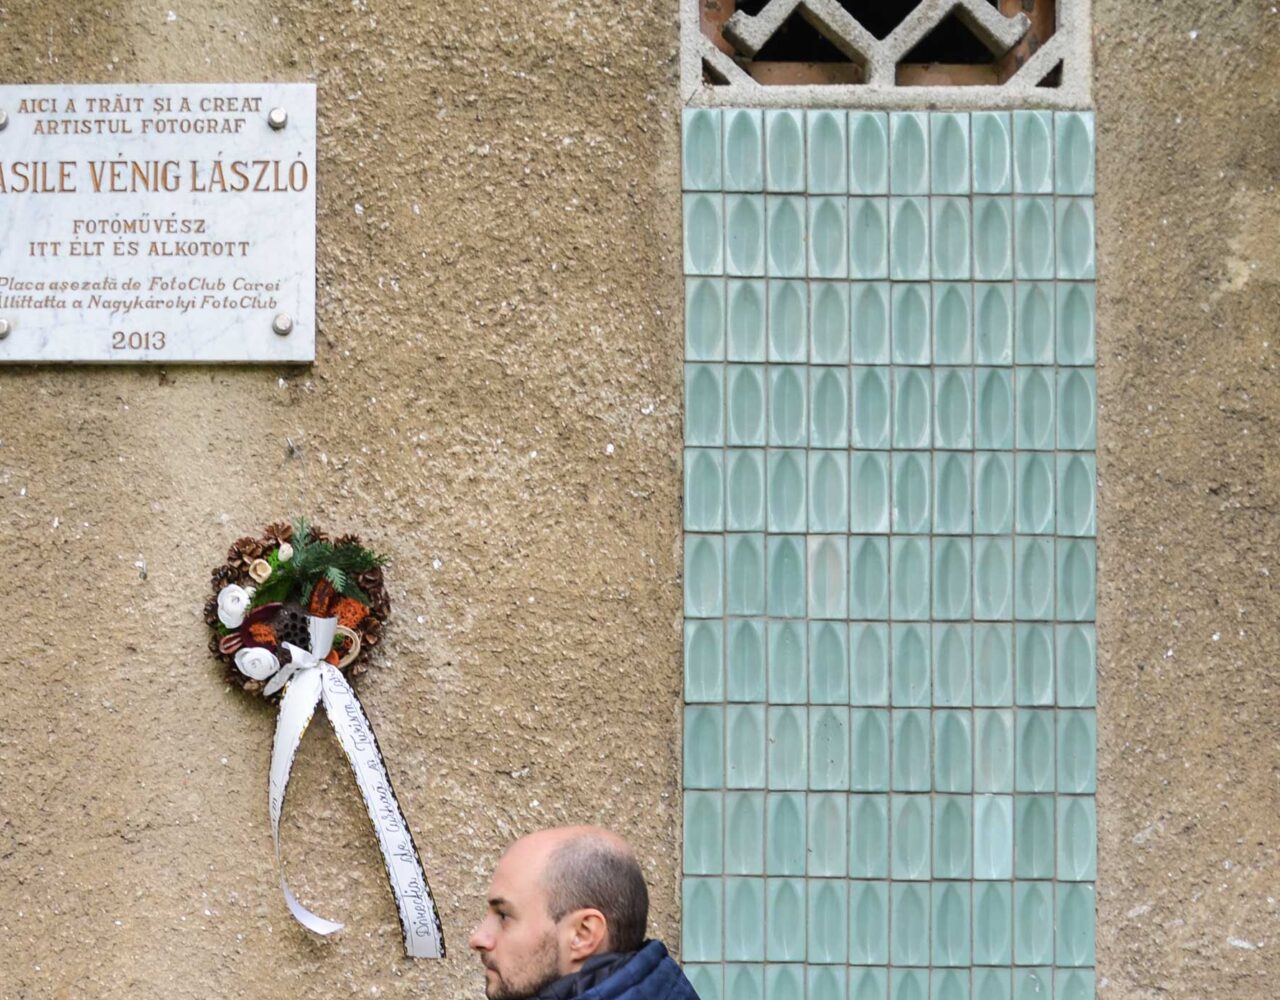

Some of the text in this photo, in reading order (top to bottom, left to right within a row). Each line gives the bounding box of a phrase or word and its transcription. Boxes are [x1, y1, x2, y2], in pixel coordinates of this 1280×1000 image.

[18, 98, 57, 113] AICI
[65, 98, 76, 113] A
[86, 94, 144, 113] TRĂIT
[179, 97, 191, 112] A
[200, 97, 262, 112] CREAT
[33, 118, 246, 135] ARTISTUL FOTOGRAF
[88, 152, 181, 193] VÉNIG
[190, 151, 308, 192] LÁSZLÓ
[29, 236, 250, 256] ITT ÉLT ÉS ALKOTOTT
[121, 278, 141, 290] de
[148, 277, 226, 291] FotoClub
[233, 277, 280, 291] Carei
[72, 299, 82, 309] a
[88, 294, 196, 315] Nagykárolyi
[200, 295, 277, 309] FotoClub
[112, 331, 166, 350] 2013
